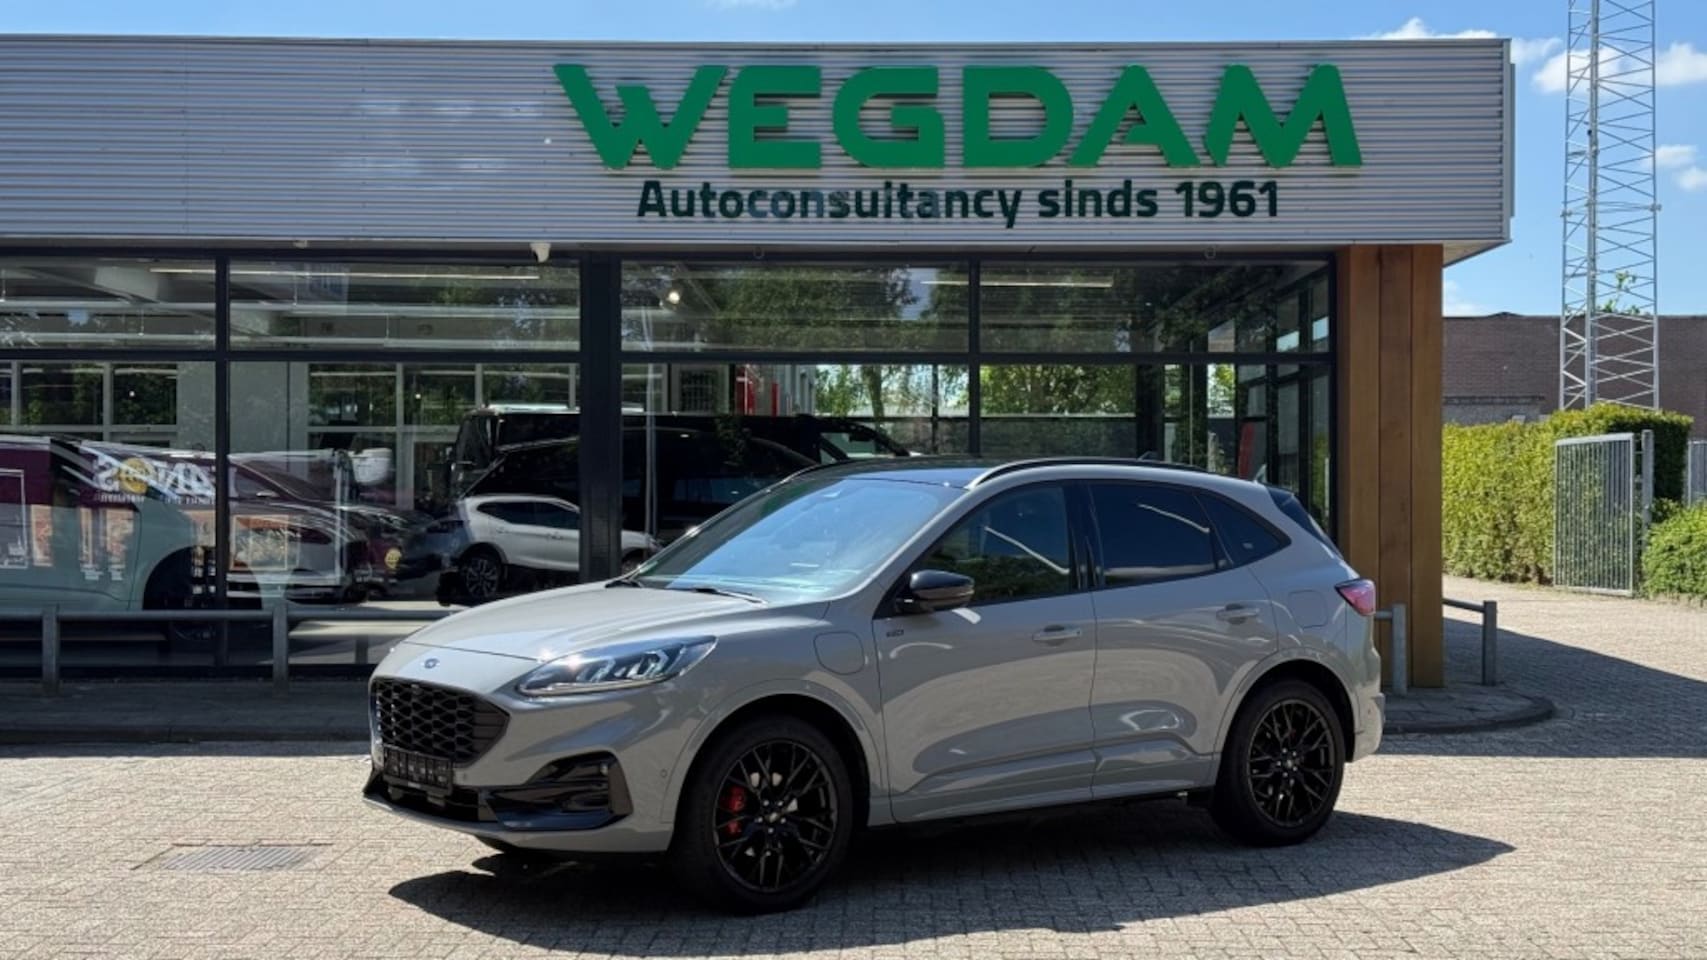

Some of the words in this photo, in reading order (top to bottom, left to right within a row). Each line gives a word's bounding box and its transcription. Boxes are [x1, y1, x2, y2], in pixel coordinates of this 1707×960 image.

[554, 64, 1362, 168] WEGDAM
[1038, 179, 1158, 218] sinds
[1174, 181, 1278, 218] 1961
